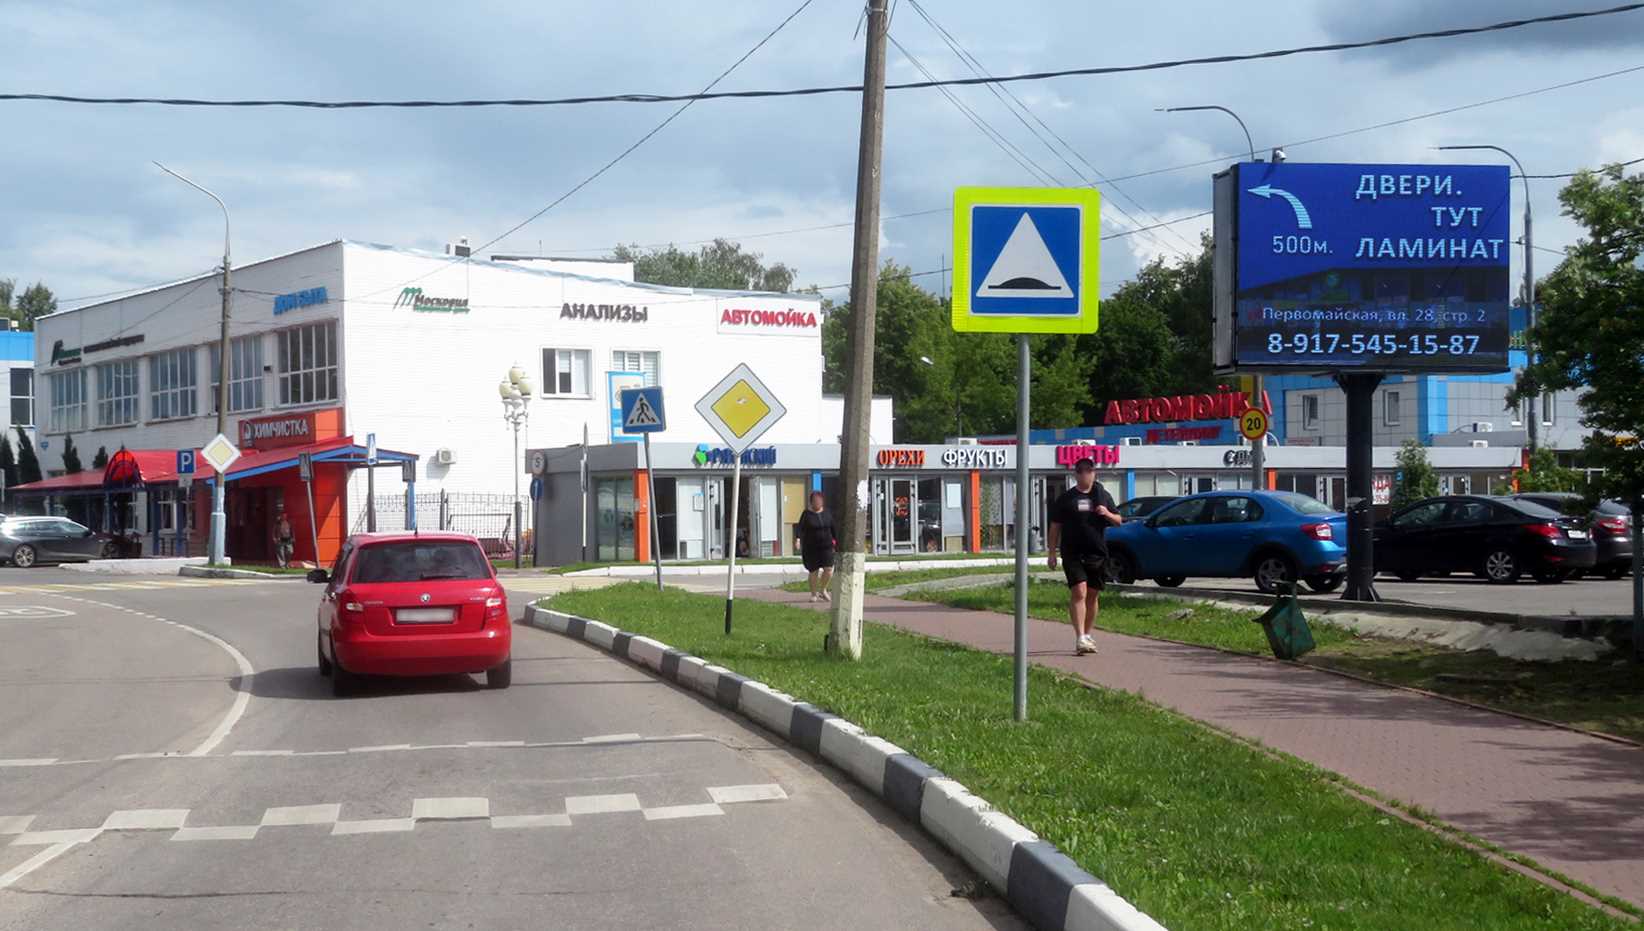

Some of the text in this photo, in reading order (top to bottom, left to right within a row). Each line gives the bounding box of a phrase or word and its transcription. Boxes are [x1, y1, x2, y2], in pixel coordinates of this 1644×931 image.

[1355, 174, 1463, 200] ДВЕРИ.
[1431, 206, 1484, 227] ТУТ
[1272, 235, 1334, 255] 500м.
[1355, 237, 1504, 260] ЛАМИНАТ
[560, 303, 648, 323] АНАЛИЗЫ
[721, 308, 817, 328] АВТОМОЙКА
[1262, 307, 1383, 323] Первомайская,
[1477, 308, 1487, 322] 2
[1267, 333, 1480, 354] 8-917-545-15-87
[254, 417, 309, 439] ХИМЧИСТКА
[1247, 417, 1261, 431] 20
[181, 452, 192, 472] P
[878, 449, 926, 466] ОРЕХИ
[943, 448, 1008, 466] ФРУКТЫ
[1056, 445, 1120, 470] ЦВЕТЫ
